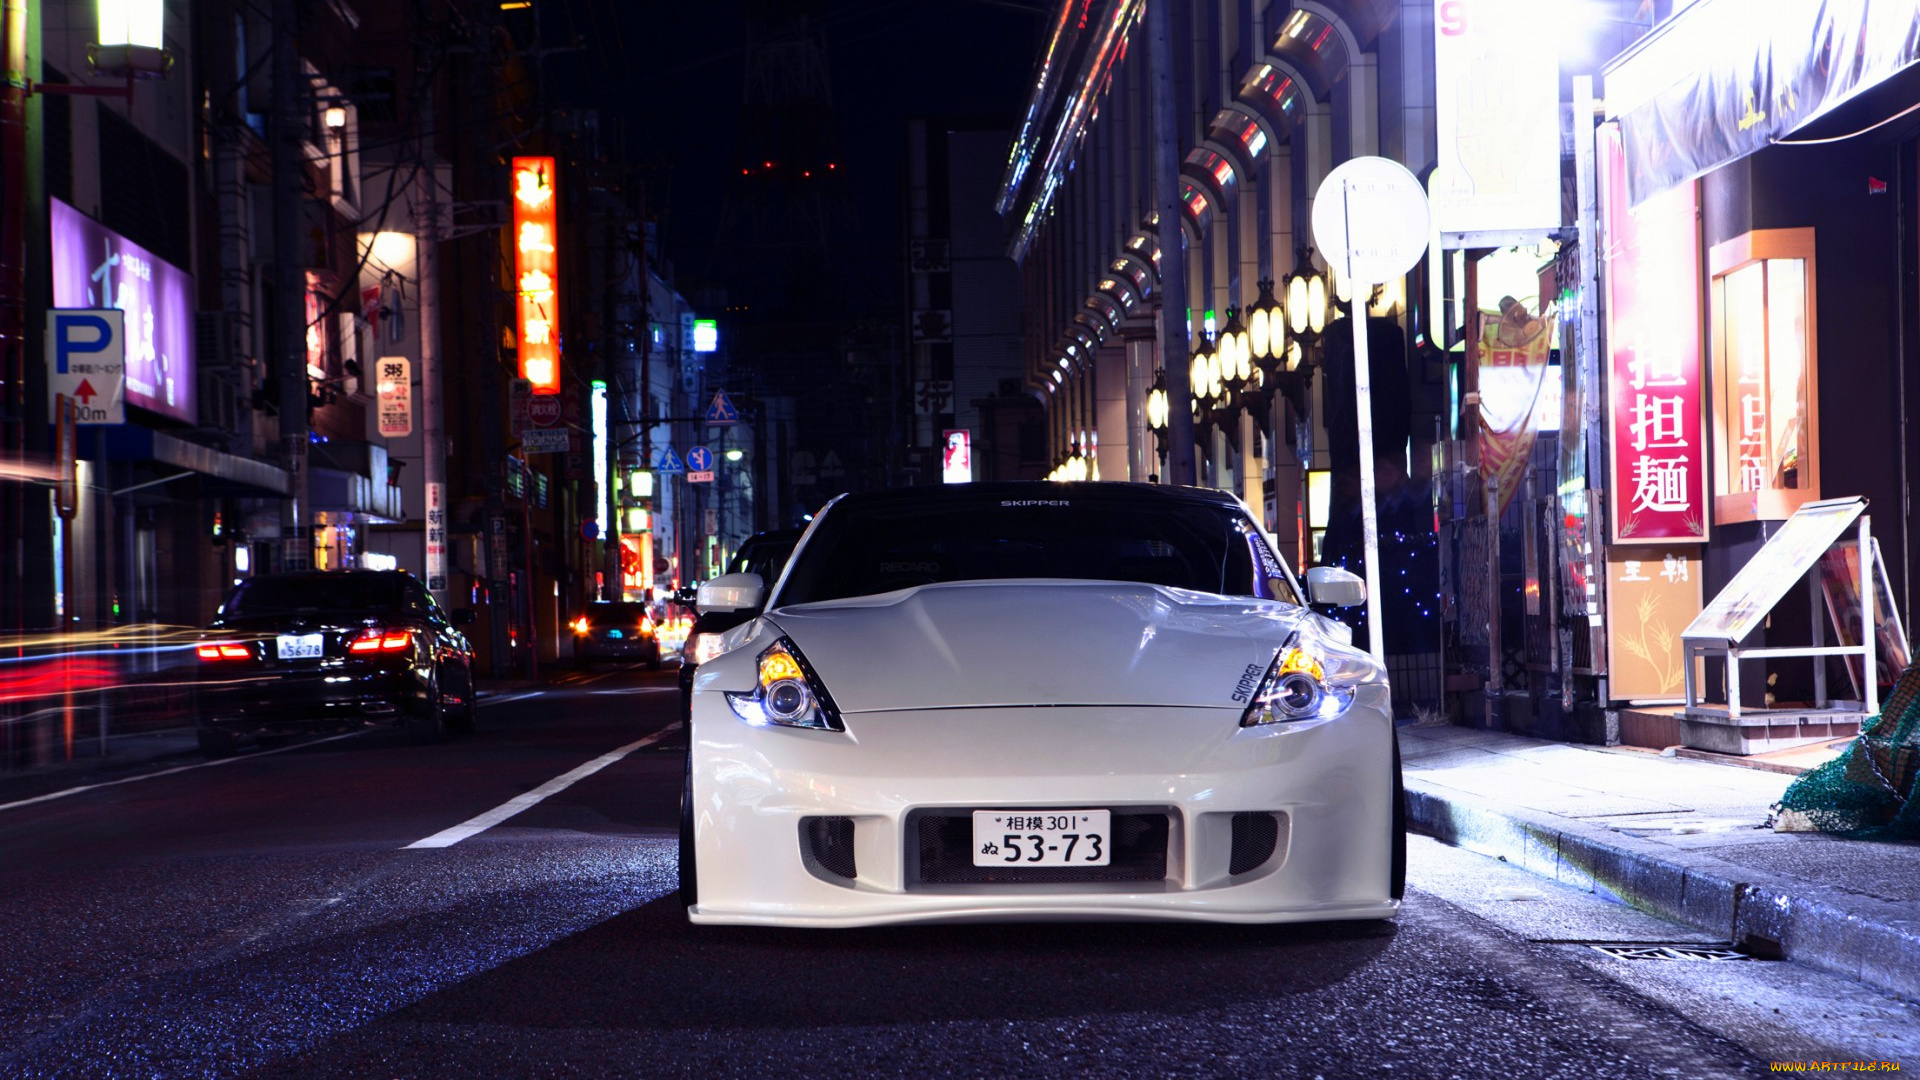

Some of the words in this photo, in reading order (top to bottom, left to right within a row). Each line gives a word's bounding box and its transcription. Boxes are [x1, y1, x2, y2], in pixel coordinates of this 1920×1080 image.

[56, 315, 112, 374] P
[880, 561, 940, 573] RECARO
[1231, 663, 1264, 704] SKIPPER
[1006, 816, 1043, 830] 相模
[1047, 816, 1076, 830] 301
[981, 842, 999, 855] ぬ
[1004, 833, 1102, 862] 53-73
